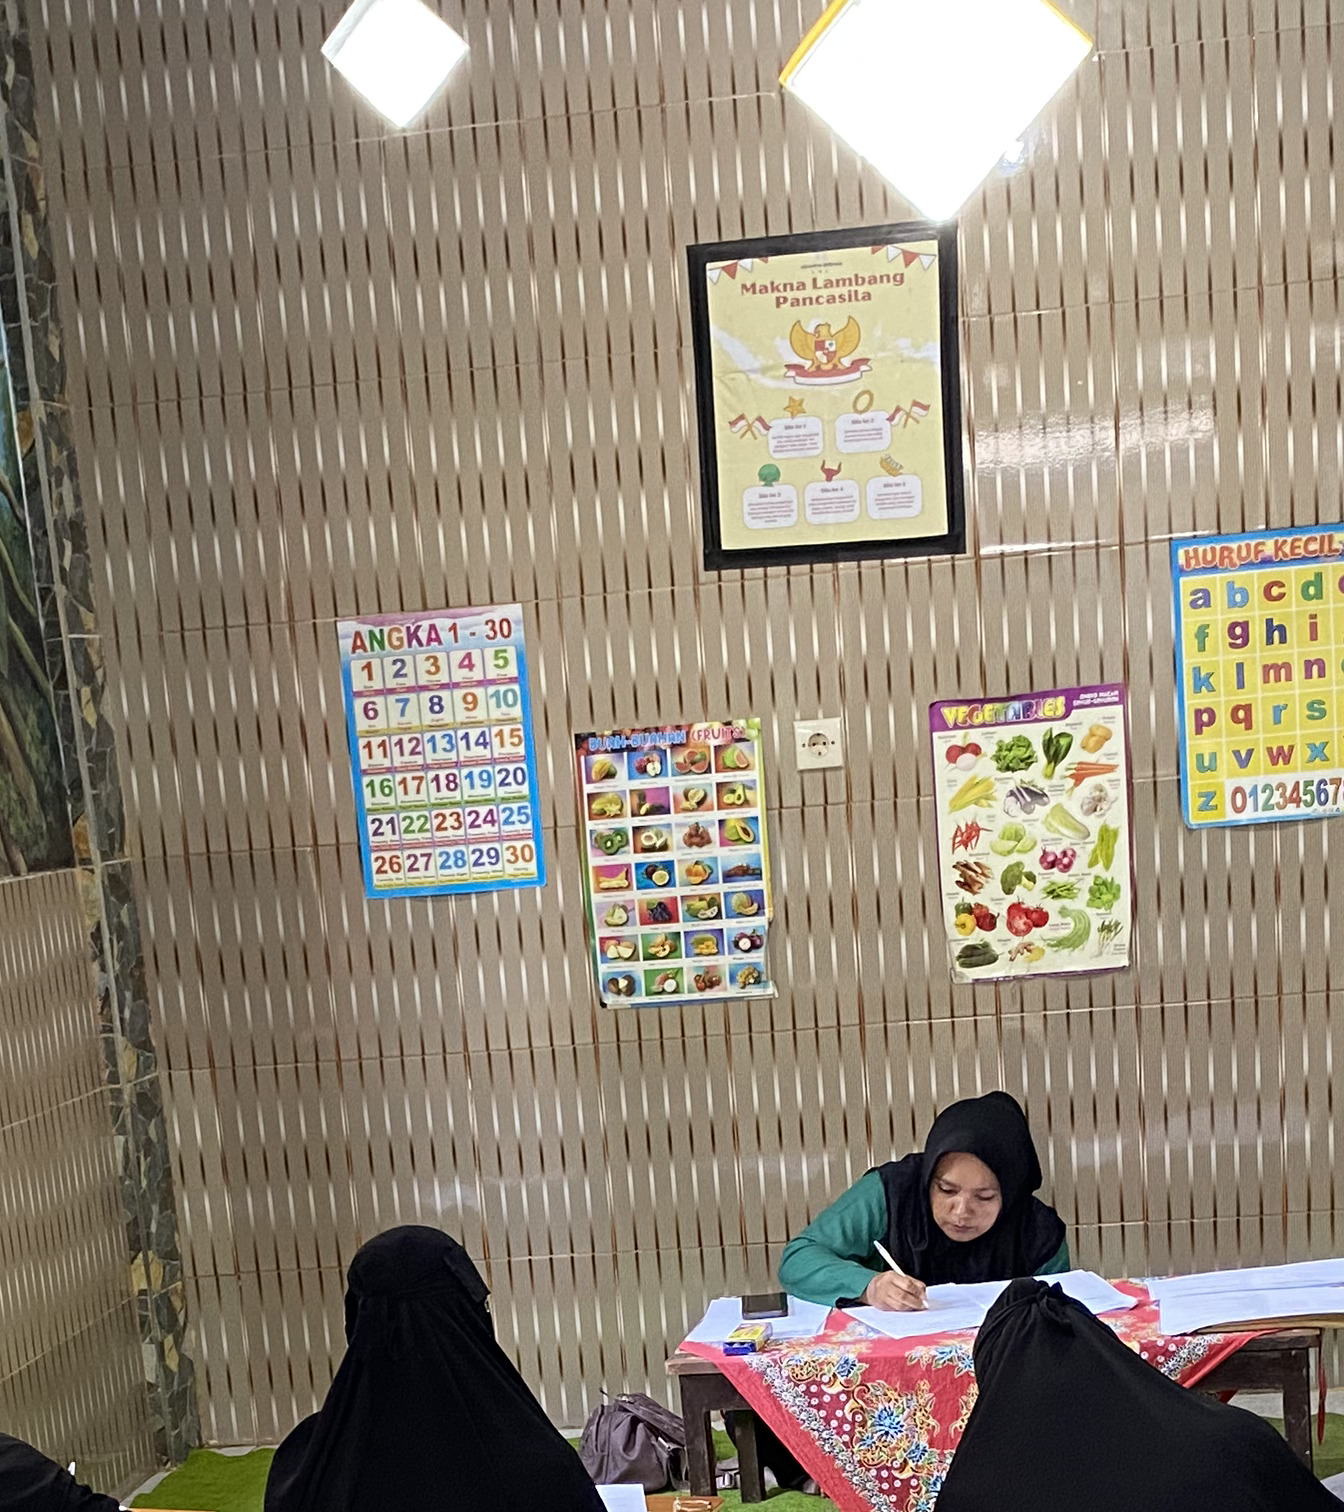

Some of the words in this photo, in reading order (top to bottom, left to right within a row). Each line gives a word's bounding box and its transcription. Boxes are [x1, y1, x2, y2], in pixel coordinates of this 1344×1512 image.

[741, 281, 807, 296] Makna
[812, 272, 905, 290] Lambang
[775, 289, 872, 309] Pancasila
[1183, 541, 1266, 570] HURUF
[1273, 533, 1342, 562] KECIL
[1189, 586, 1212, 610] a
[1226, 580, 1250, 609] b
[1262, 580, 1287, 602] c
[1300, 571, 1323, 601] d
[350, 624, 443, 655] ANGKA
[448, 622, 459, 644] 1
[484, 617, 513, 641] 30
[1194, 623, 1210, 652] f
[1227, 620, 1250, 649] g
[1265, 618, 1287, 646] h
[1308, 613, 1318, 642] i
[361, 661, 374, 681] 1
[391, 658, 408, 679] 2
[425, 655, 441, 676] 3
[458, 652, 476, 672] 4
[493, 649, 509, 670] 5
[1192, 665, 1216, 694] k
[1235, 662, 1245, 690] l
[1262, 660, 1293, 685] m
[1303, 657, 1326, 680] n
[362, 700, 379, 721] 6
[395, 698, 411, 717] 7
[428, 695, 445, 715] 8
[462, 692, 479, 712] 9
[489, 688, 519, 709] 10
[941, 696, 1066, 728] VEGETABLES
[1194, 706, 1216, 736] p
[1230, 703, 1253, 731] q
[1272, 703, 1288, 725] r
[1305, 699, 1327, 720] s
[362, 738, 389, 760] 11
[393, 736, 423, 758] 12
[426, 733, 456, 755] 13
[459, 730, 490, 752] 14
[494, 728, 524, 748] 15
[1195, 751, 1217, 774] u
[1231, 748, 1255, 769] v
[1266, 744, 1295, 766] w
[1305, 741, 1330, 763] x
[365, 777, 394, 799] 16
[398, 775, 425, 796] 17
[430, 772, 459, 794] 18
[464, 769, 493, 790] 19
[497, 766, 527, 788] 20
[1197, 789, 1217, 812] z
[370, 816, 397, 838] 21
[401, 814, 431, 835] 22
[434, 811, 463, 833] 23
[466, 808, 498, 829] 24
[501, 805, 532, 826] 25
[373, 854, 402, 875] 26
[406, 852, 433, 873] 27
[438, 849, 467, 870] 28
[471, 846, 501, 868] 29
[505, 843, 534, 865] 30
